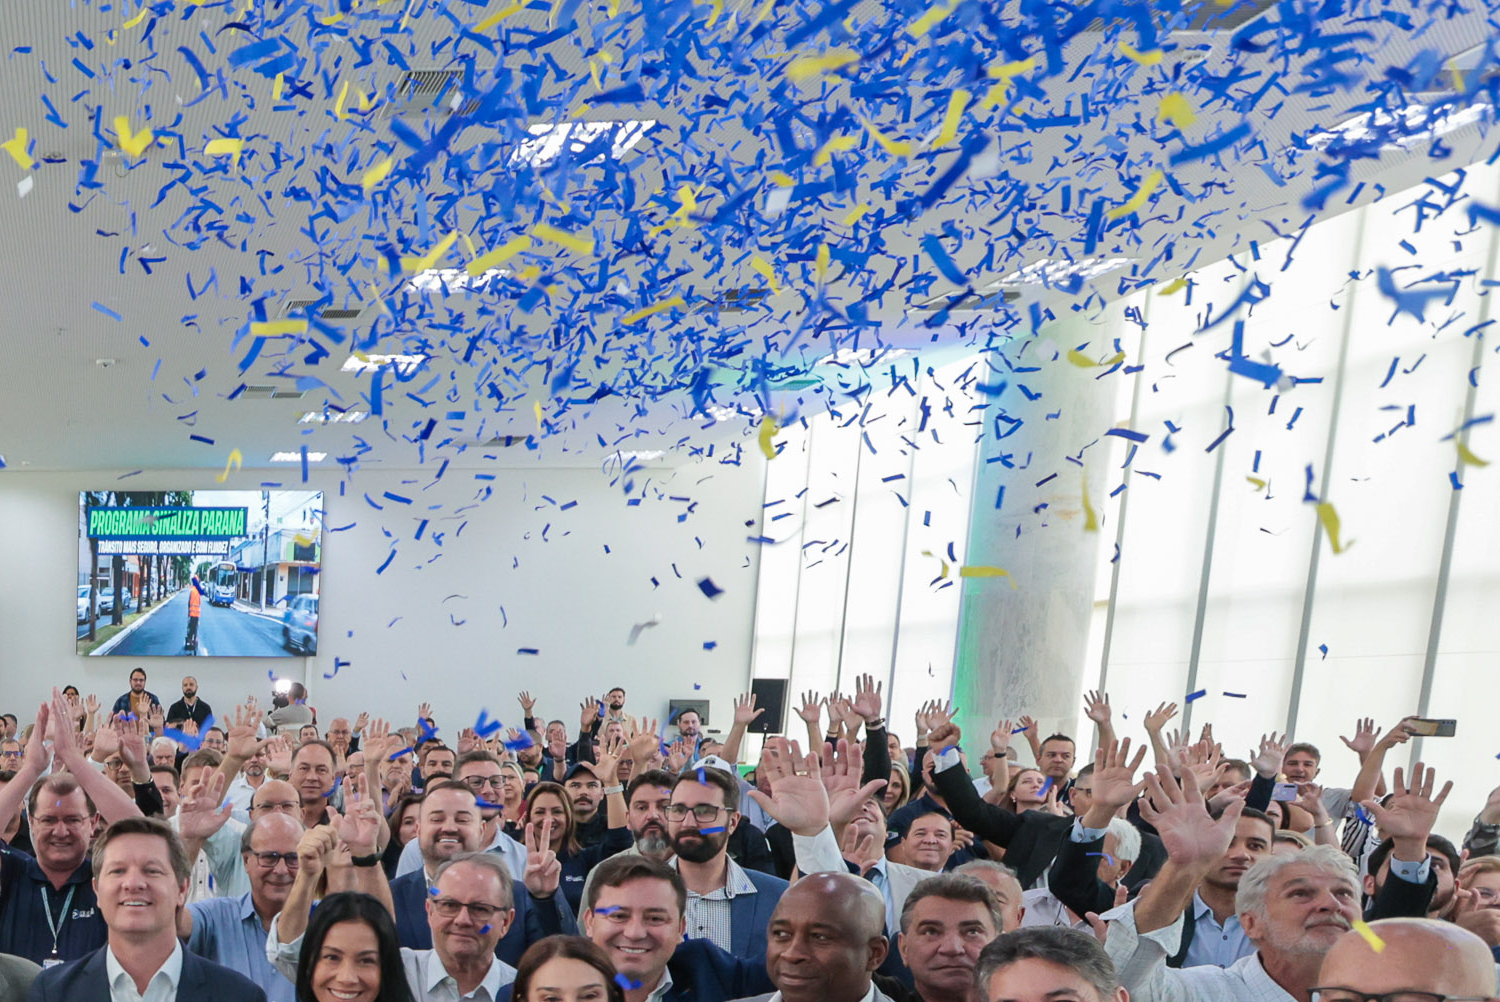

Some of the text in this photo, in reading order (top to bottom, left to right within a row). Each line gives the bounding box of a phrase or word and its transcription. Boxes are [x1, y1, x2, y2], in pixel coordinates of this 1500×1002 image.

[89, 508, 244, 535] PROGRAMA SINALIZA PARANÁ
